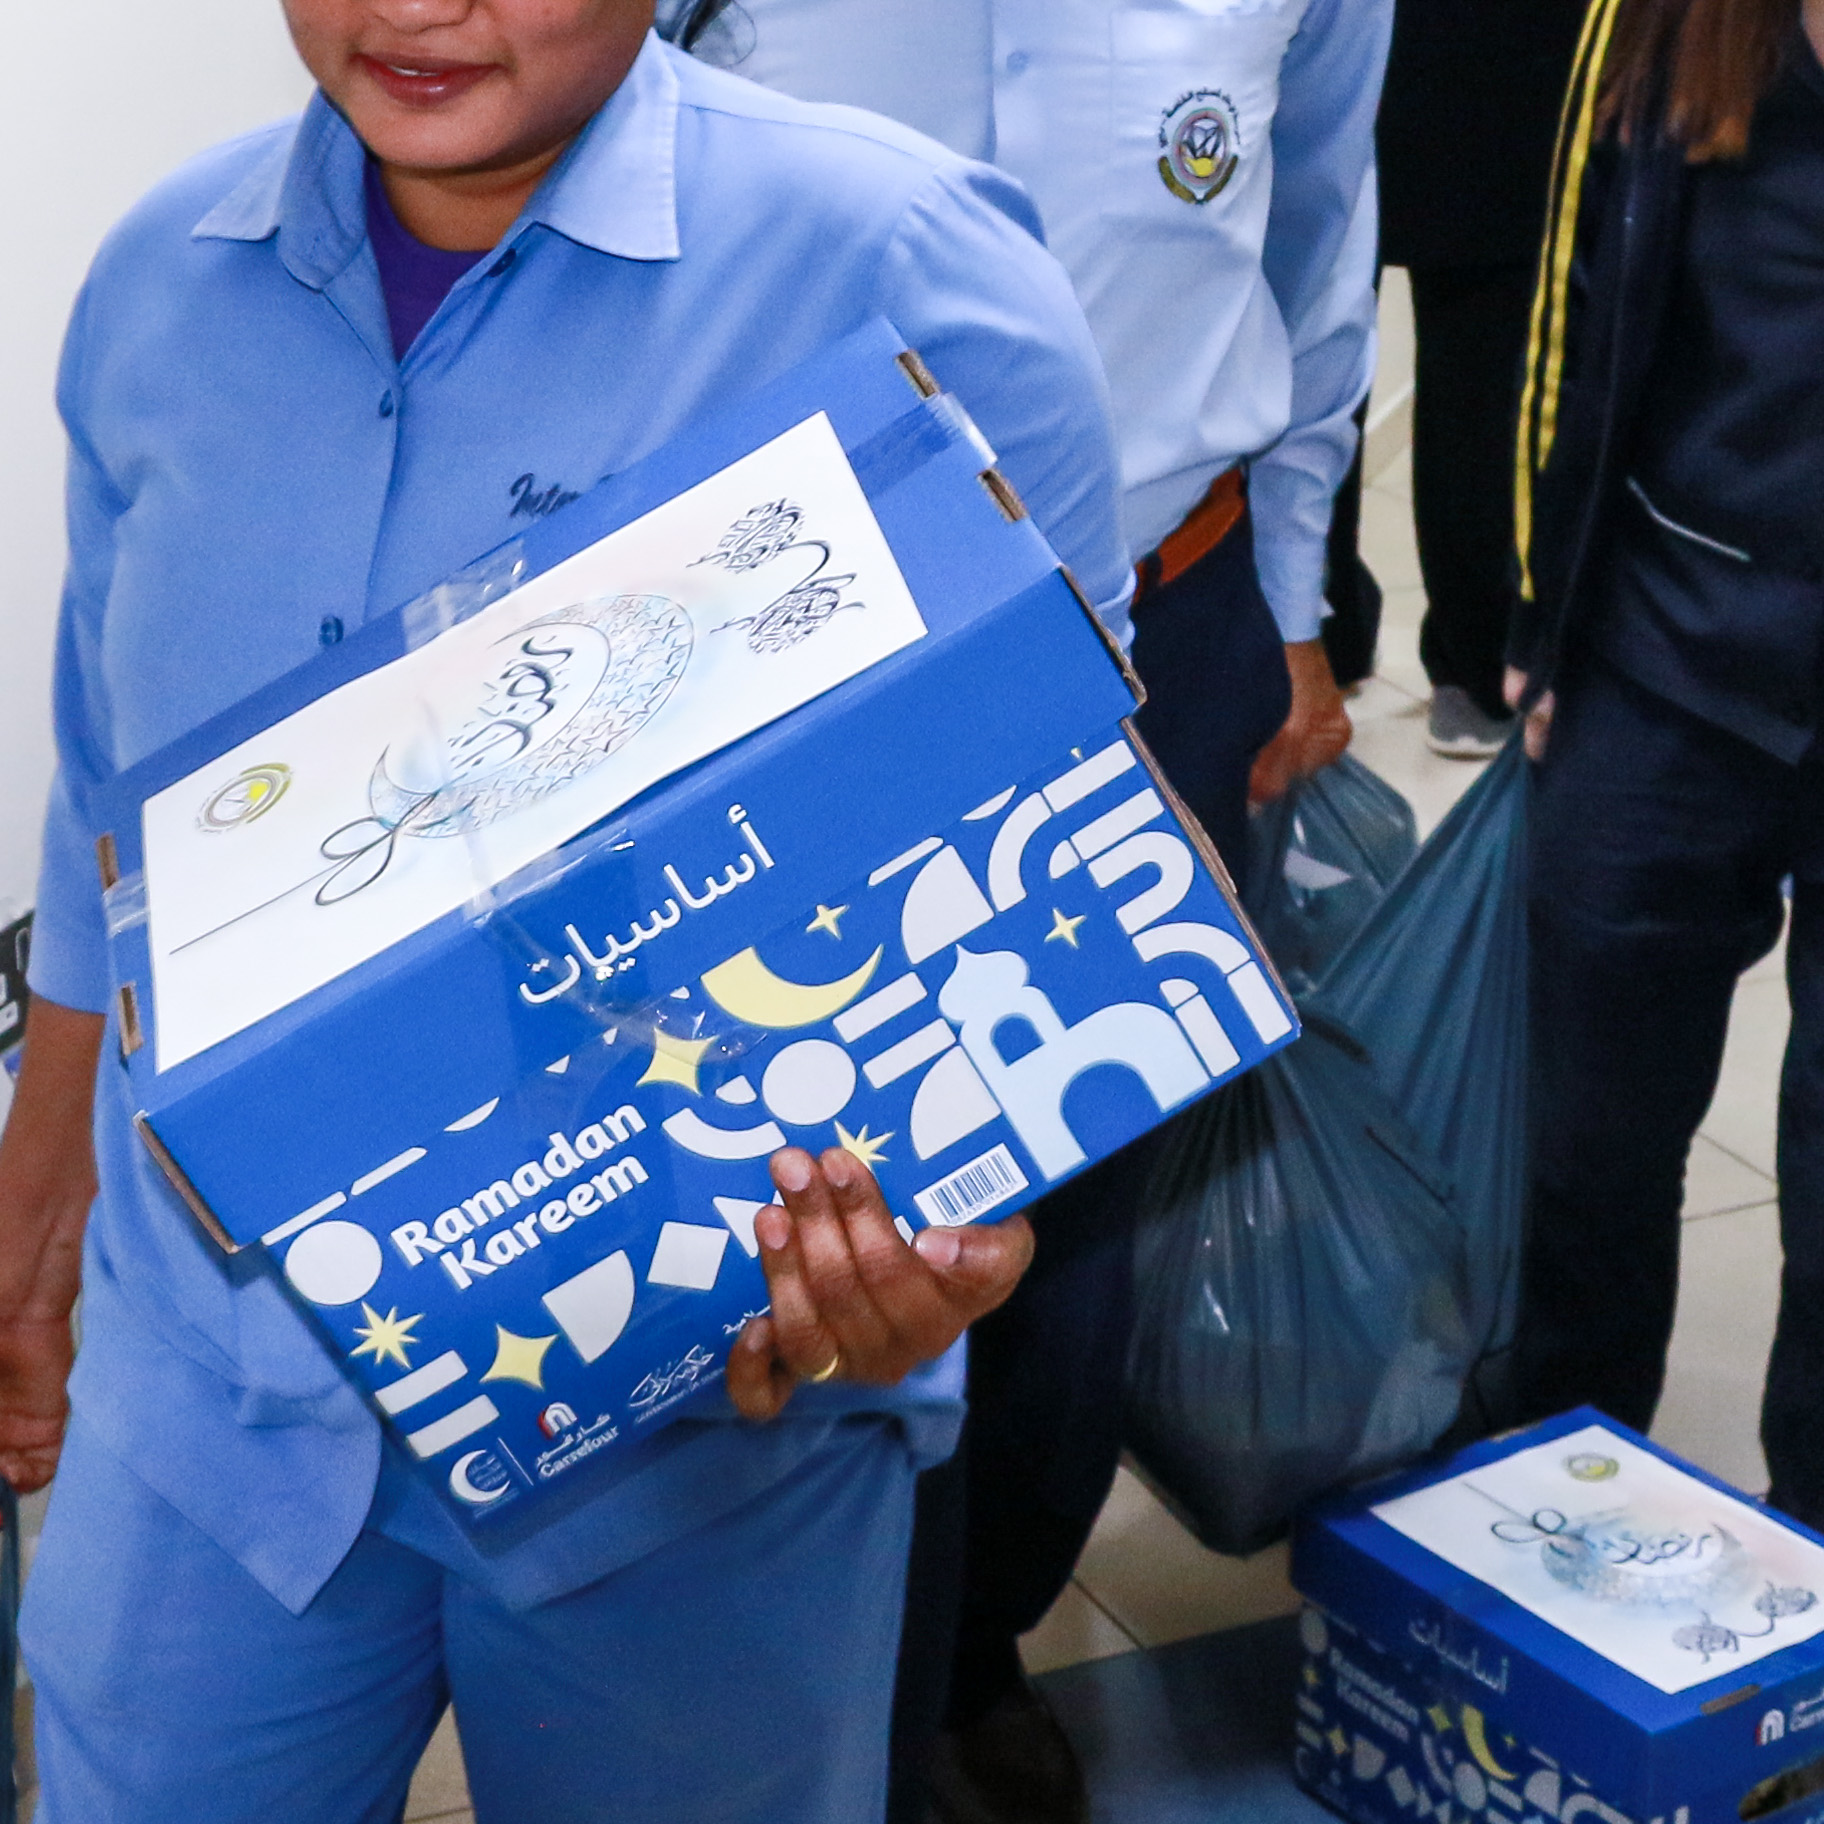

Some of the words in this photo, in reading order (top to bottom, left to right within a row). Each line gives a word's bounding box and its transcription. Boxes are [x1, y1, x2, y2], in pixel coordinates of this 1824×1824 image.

[519, 804, 775, 1004] أساسيات
[390, 1104, 648, 1267] Ramadan
[439, 1155, 650, 1291] Kareem
[538, 1424, 620, 1479] Carrefour
